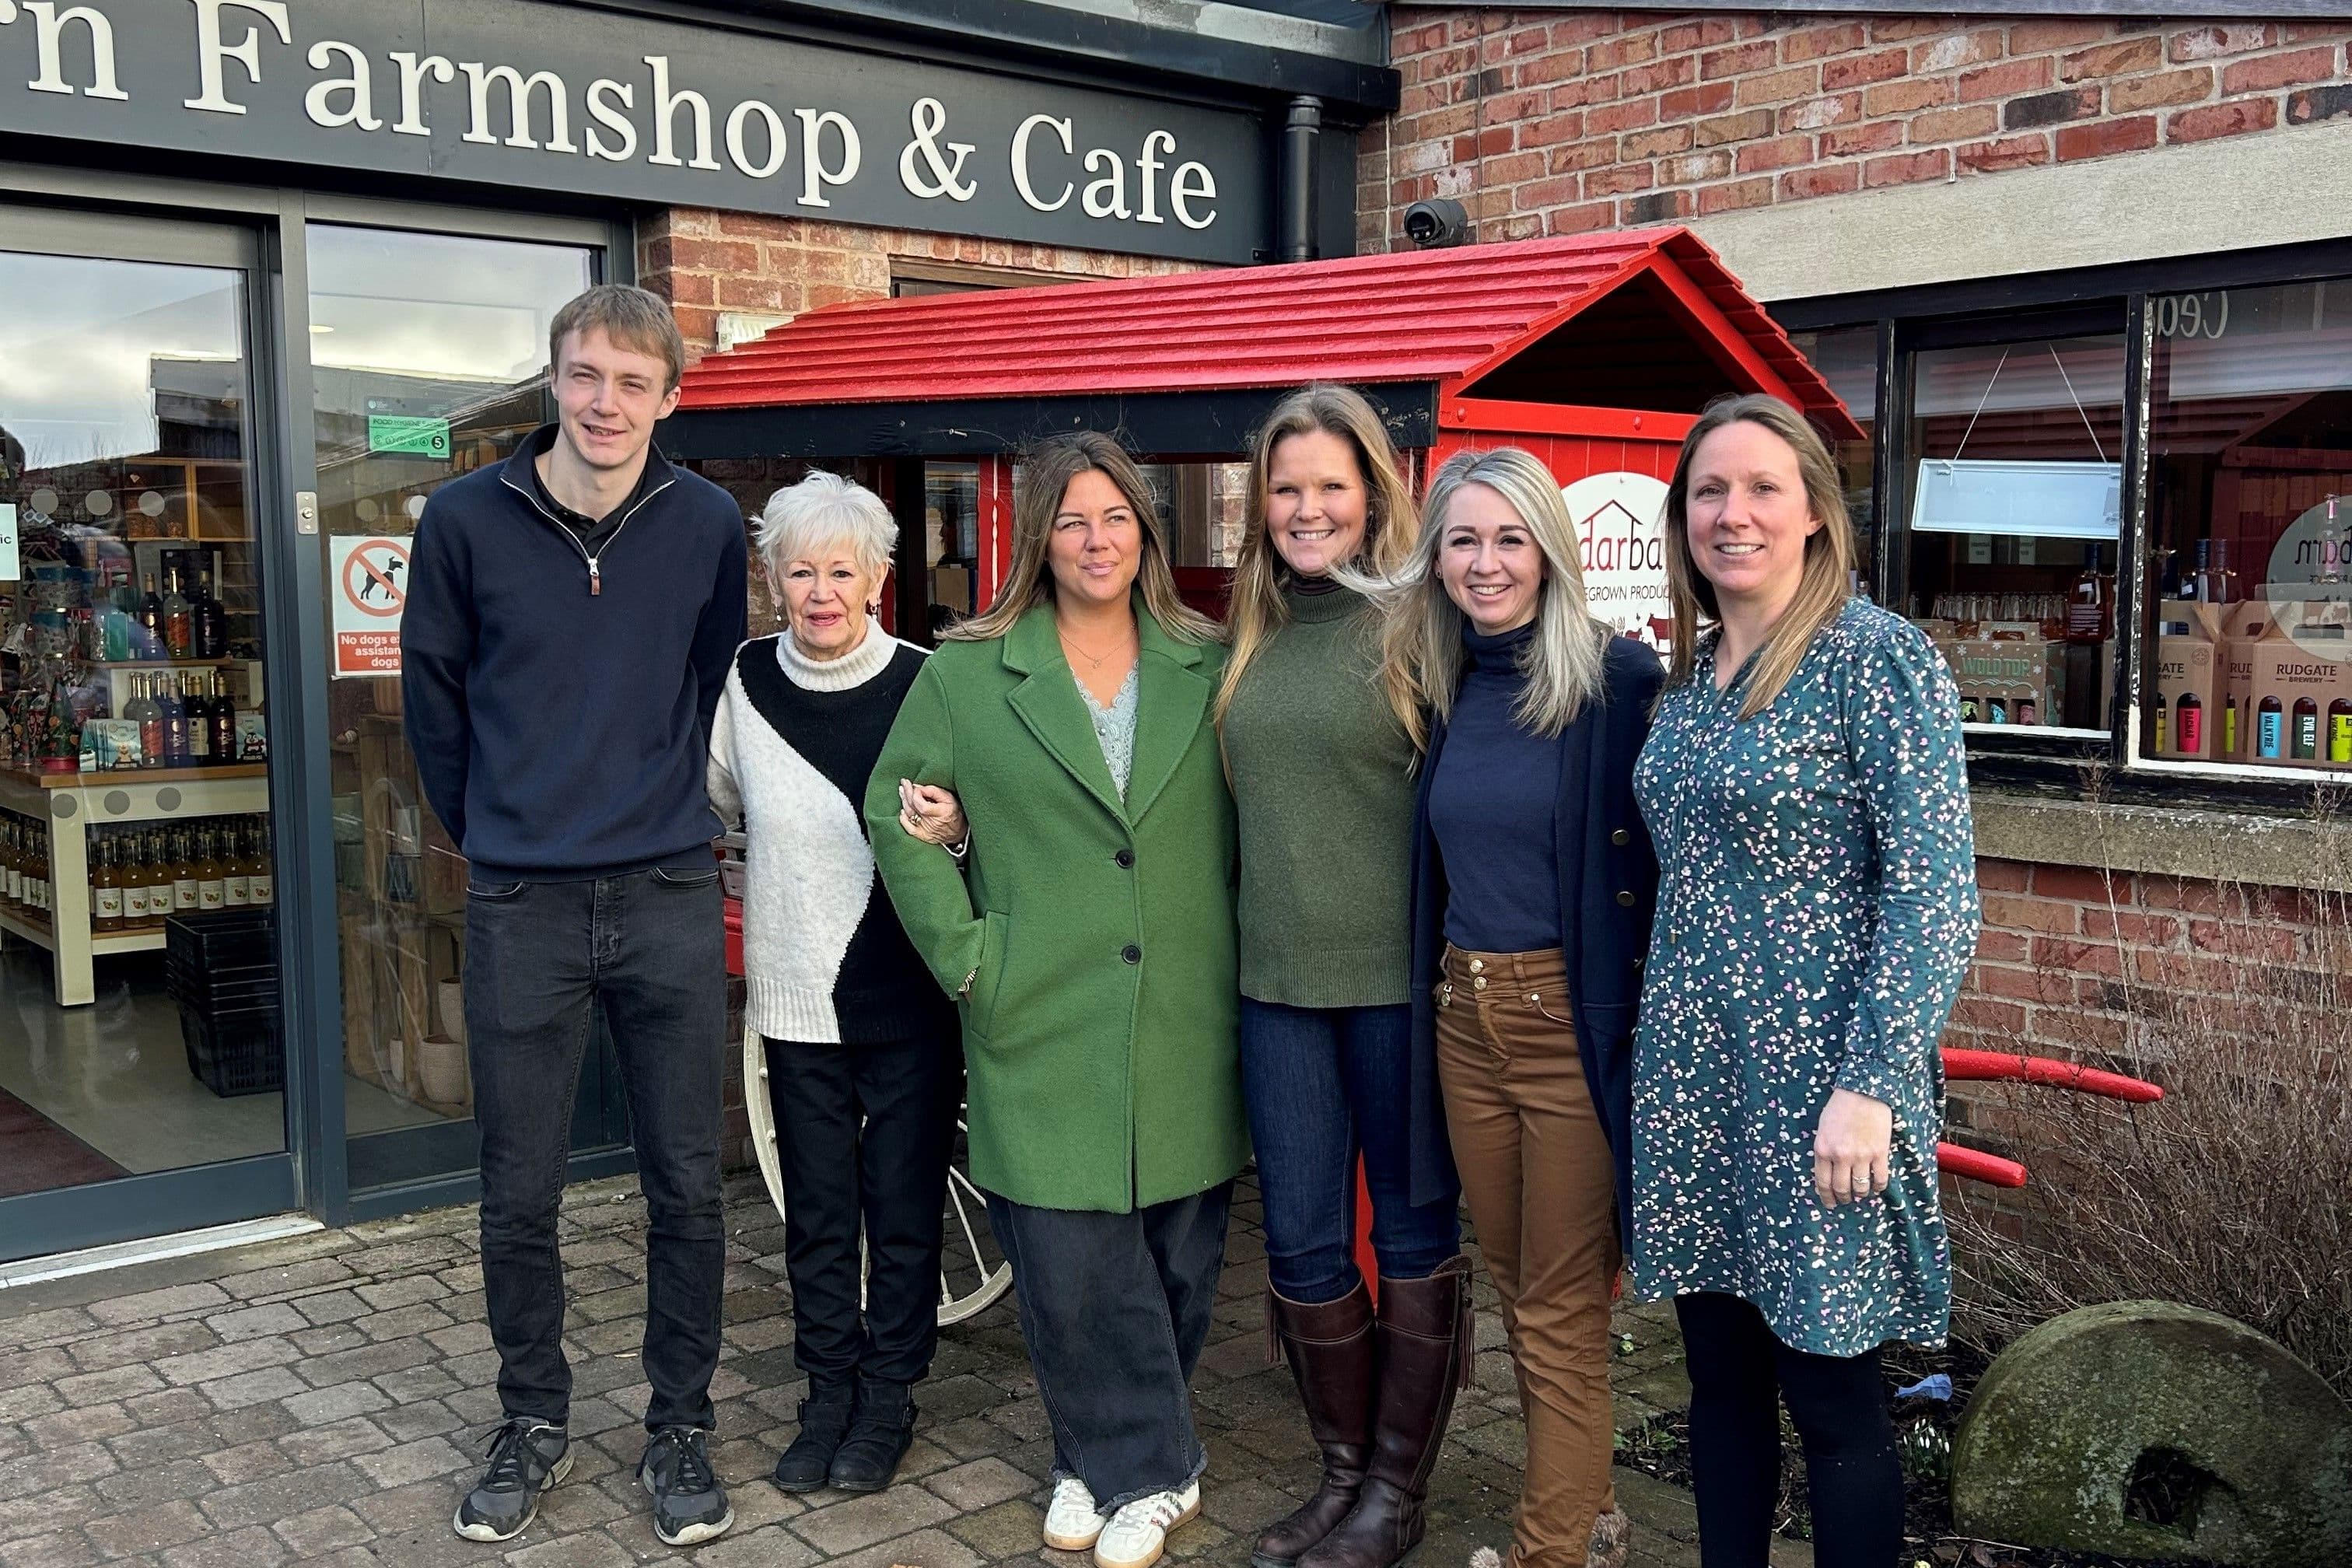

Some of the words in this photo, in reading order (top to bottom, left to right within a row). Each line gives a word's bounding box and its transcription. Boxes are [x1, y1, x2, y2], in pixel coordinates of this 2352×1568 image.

[183, 0, 862, 208] Farmshop
[899, 96, 978, 202] &
[1010, 113, 1217, 230] Cafe
[434, 438, 443, 448] 5
[341, 635, 358, 645] No
[359, 635, 387, 647] dogs
[371, 657, 399, 669] dogs
[1962, 657, 2001, 676] WOLD
[2003, 658, 2031, 677] TOP
[2277, 664, 2337, 676] RUDGATE
[2263, 714, 2275, 749] VALKYRIE
[2303, 733, 2315, 747] ELF
